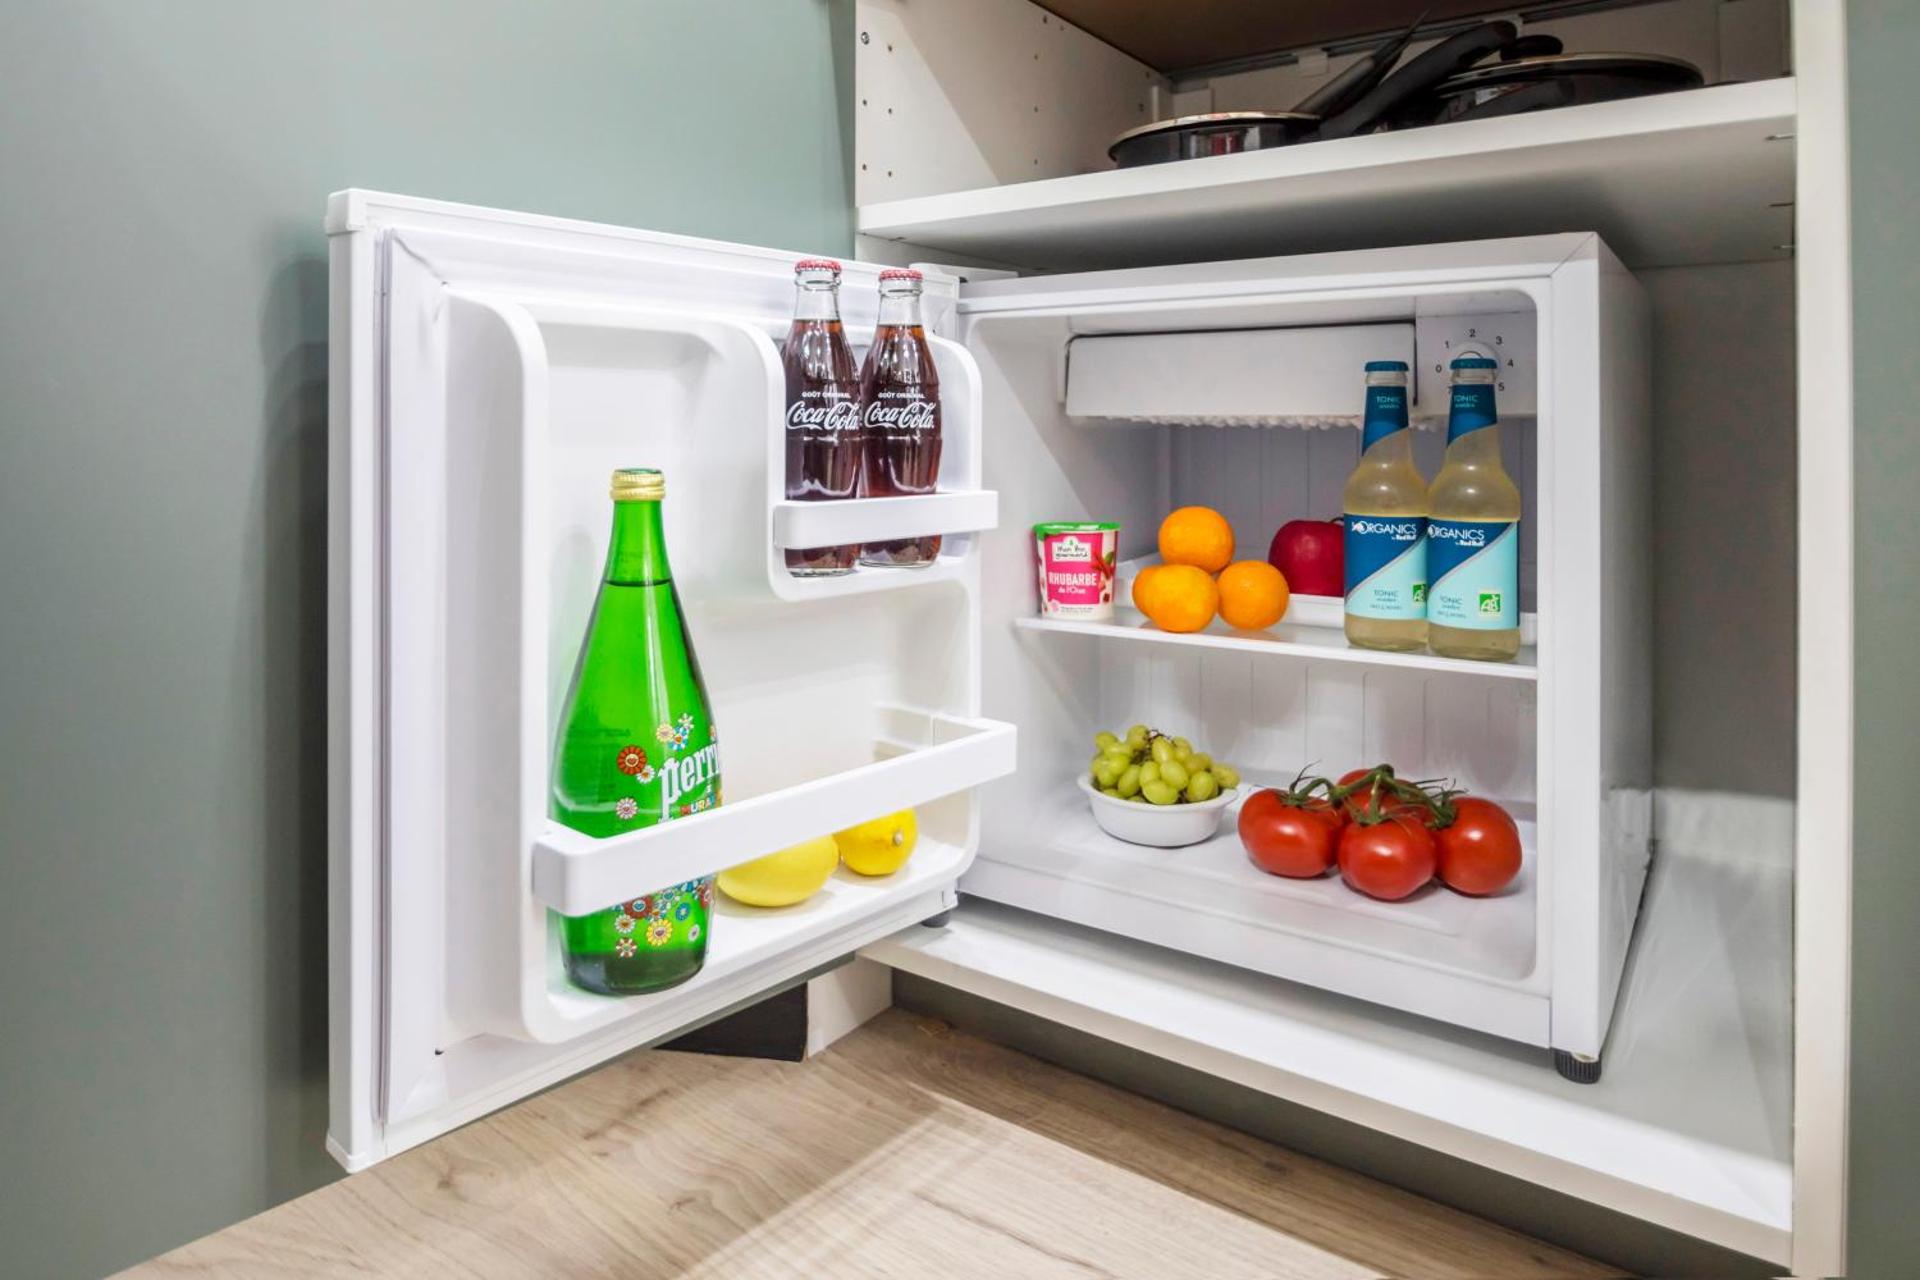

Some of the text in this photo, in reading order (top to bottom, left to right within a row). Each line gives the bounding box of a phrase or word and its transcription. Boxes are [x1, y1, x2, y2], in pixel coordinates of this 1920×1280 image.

[1469, 328, 1476, 338] 2
[1495, 336, 1503, 345] 3
[1506, 359, 1514, 367] 4
[1435, 364, 1442, 373] 0
[1498, 382, 1505, 391] 5
[1048, 571, 1097, 586] RHUBARBE
